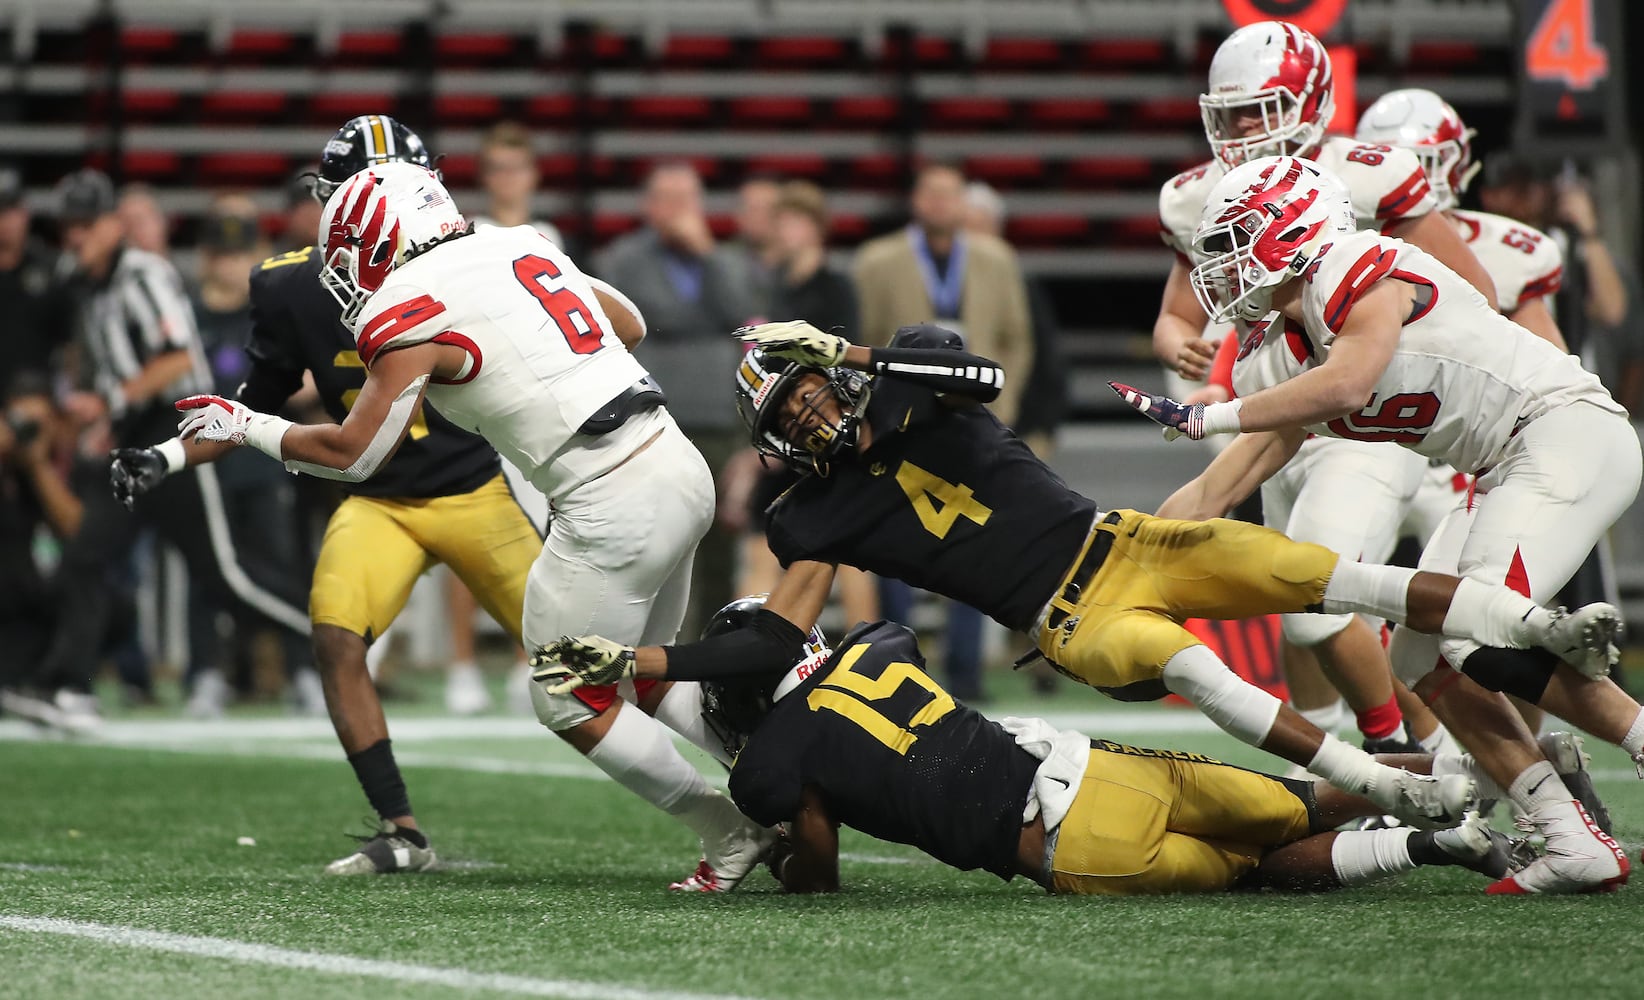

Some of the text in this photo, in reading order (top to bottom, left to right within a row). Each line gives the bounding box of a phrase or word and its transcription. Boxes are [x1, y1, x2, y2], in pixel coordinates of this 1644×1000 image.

[1525, 0, 1609, 90] 4
[512, 253, 606, 355] 6
[755, 375, 775, 406] Riddell
[895, 459, 993, 540] 4
[806, 642, 957, 757] 15
